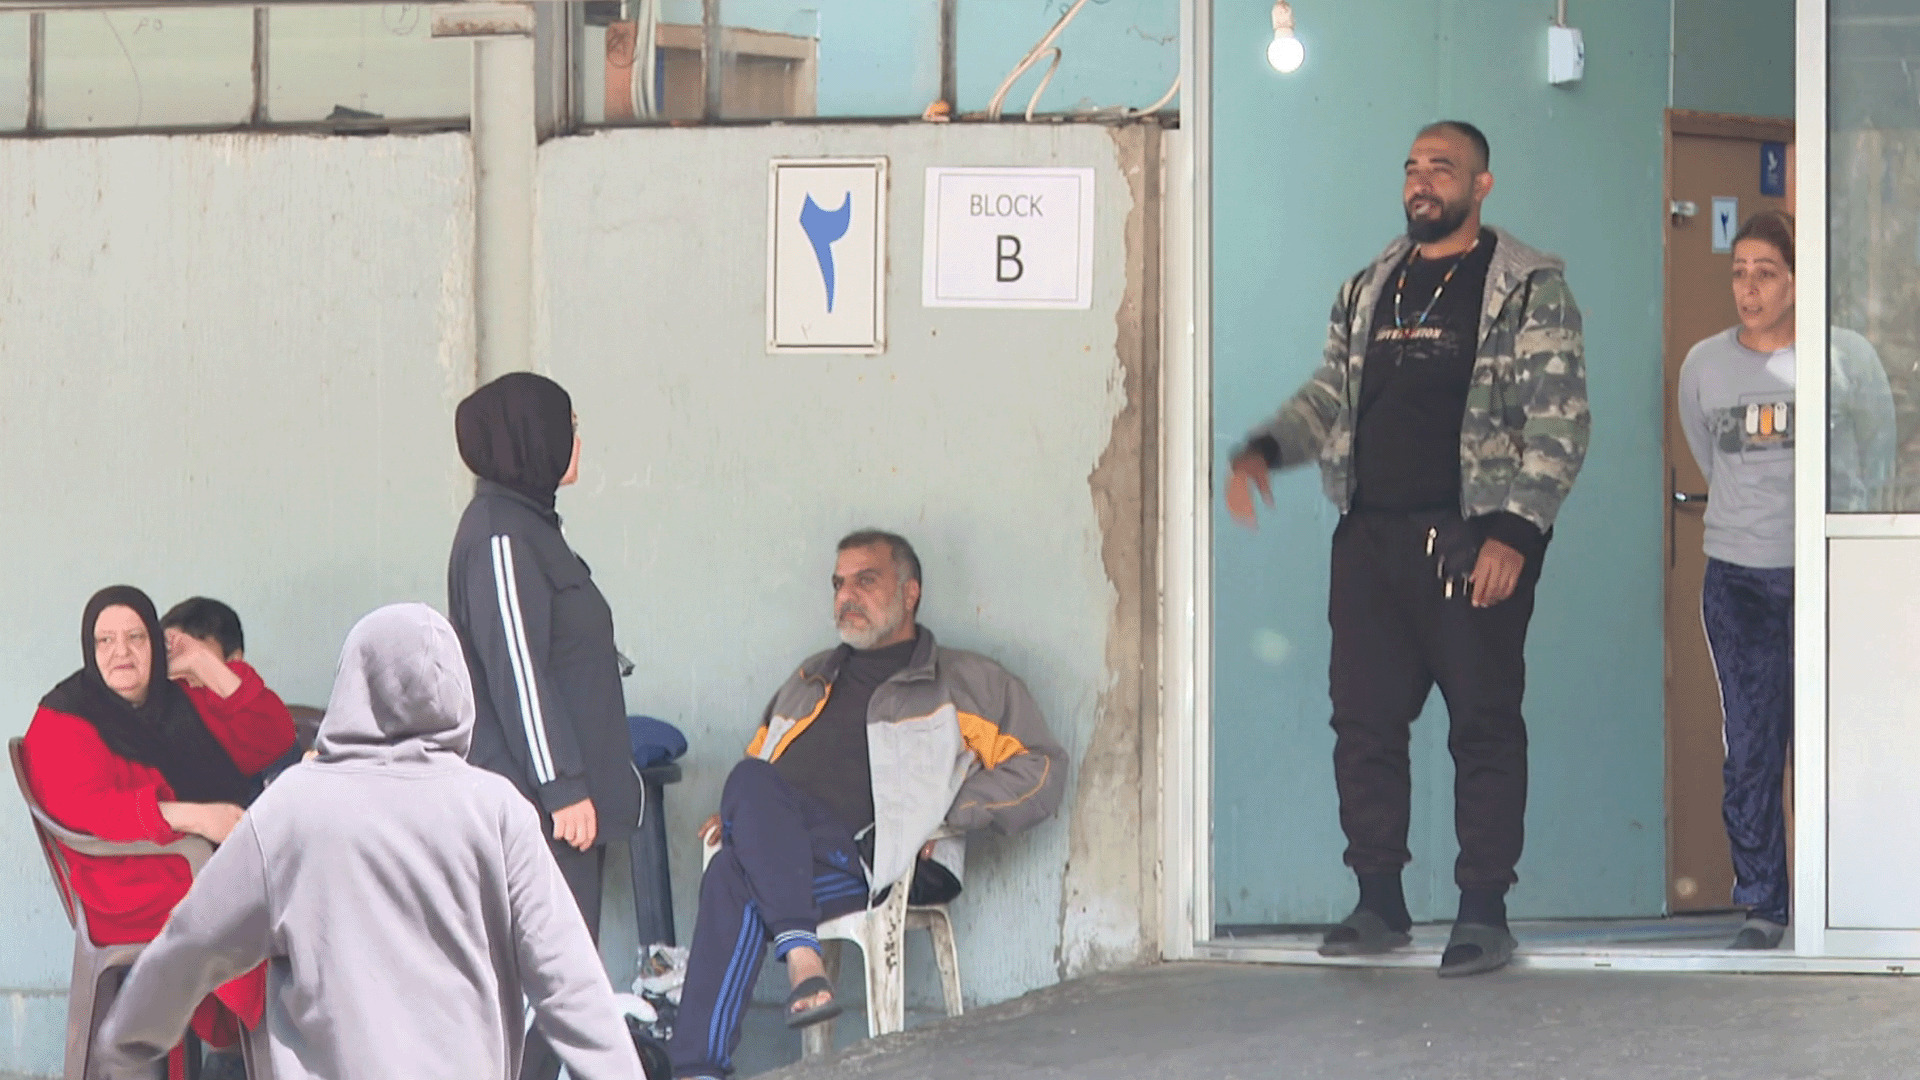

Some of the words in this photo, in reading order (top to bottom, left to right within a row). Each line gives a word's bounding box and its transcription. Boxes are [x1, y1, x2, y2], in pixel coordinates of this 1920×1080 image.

[969, 194, 1044, 217] BLOCK
[800, 190, 851, 314] ٢
[996, 235, 1024, 282] B
